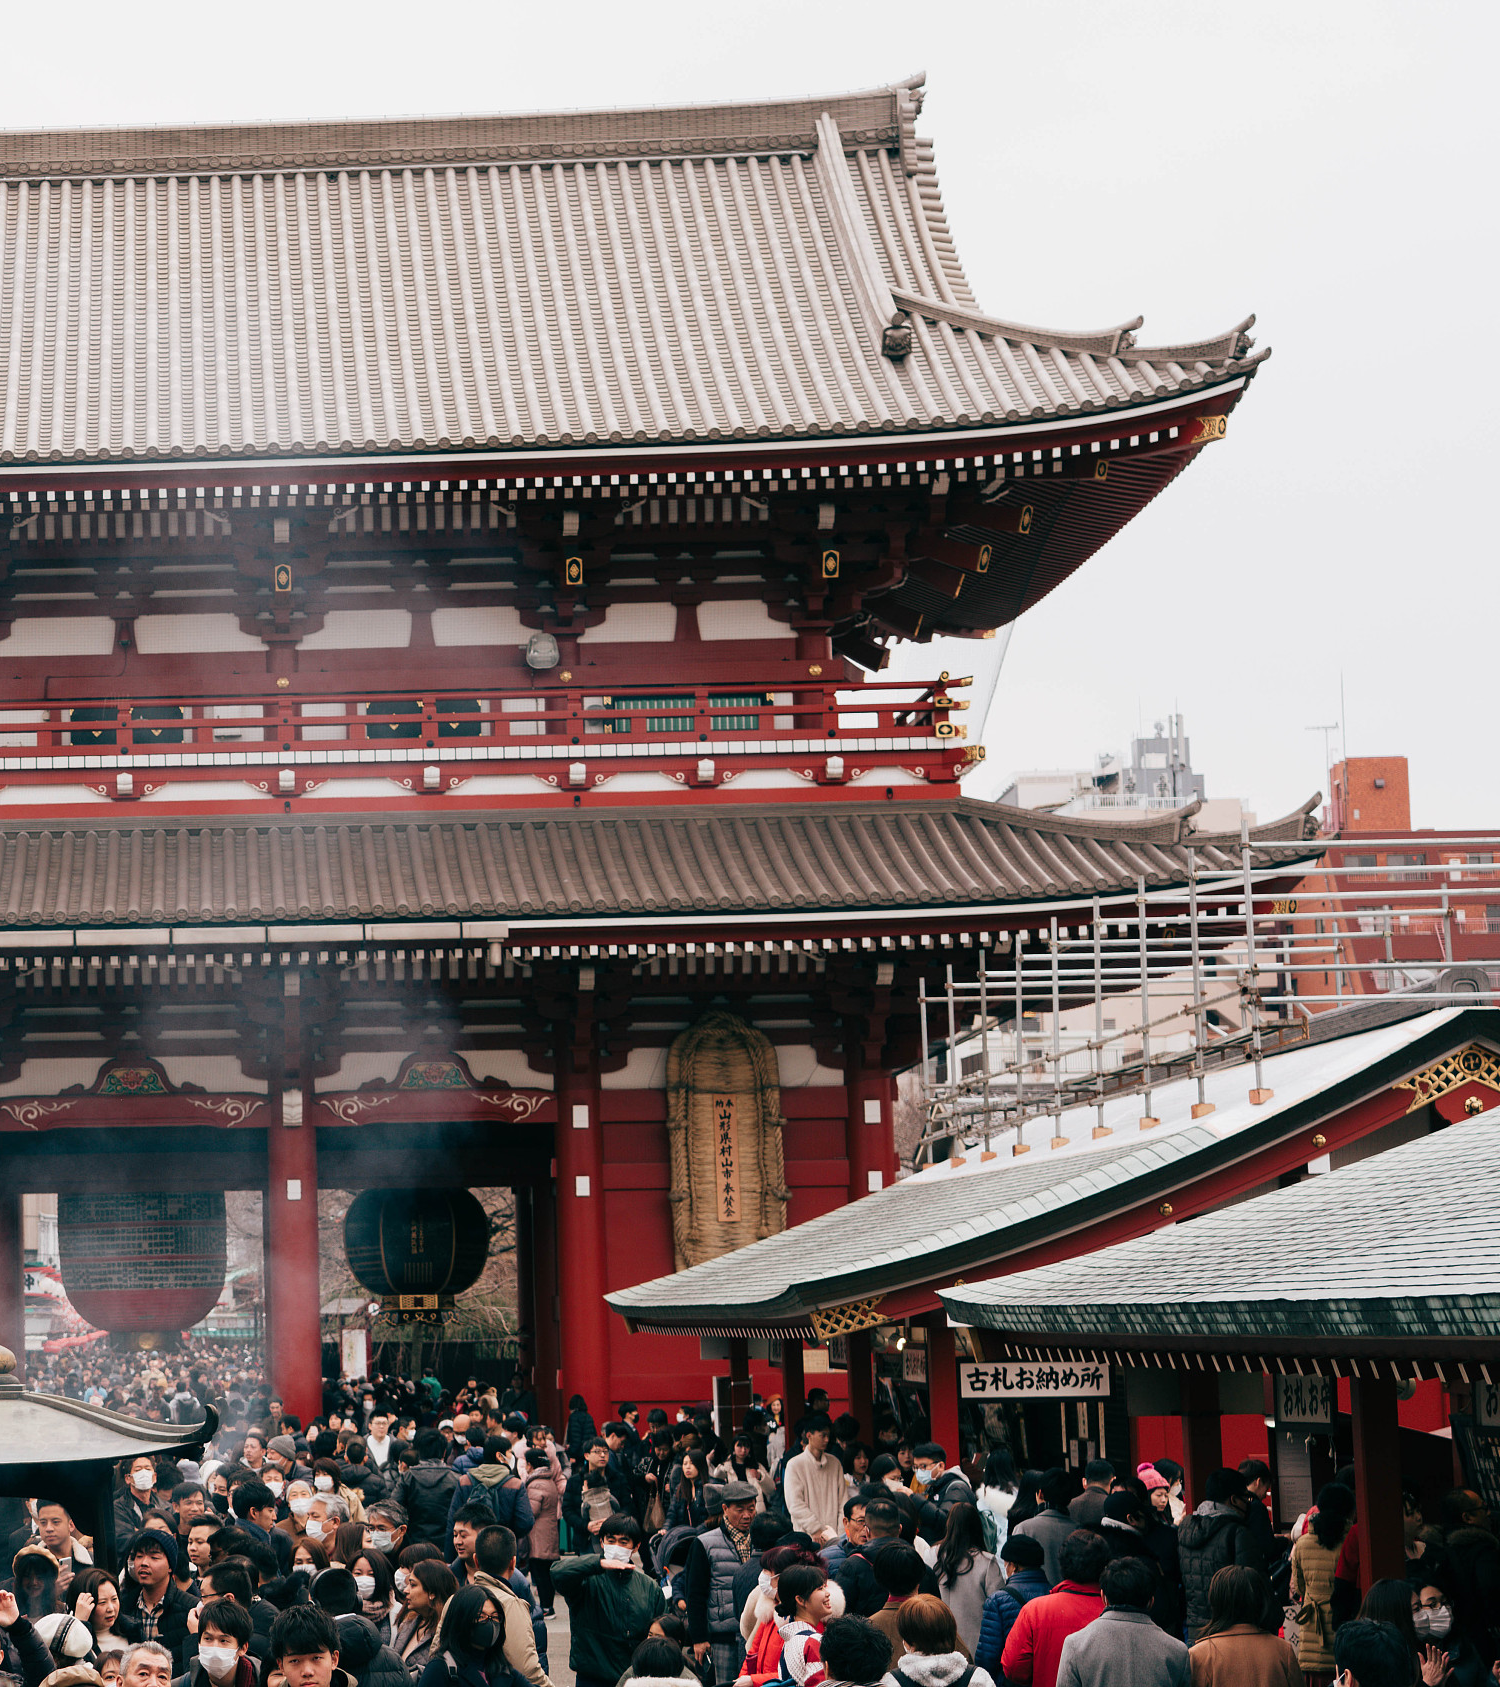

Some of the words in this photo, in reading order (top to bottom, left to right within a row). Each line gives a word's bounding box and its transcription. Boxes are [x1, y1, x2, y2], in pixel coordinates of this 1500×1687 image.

[966, 1365, 1104, 1392] 古札お納め所
